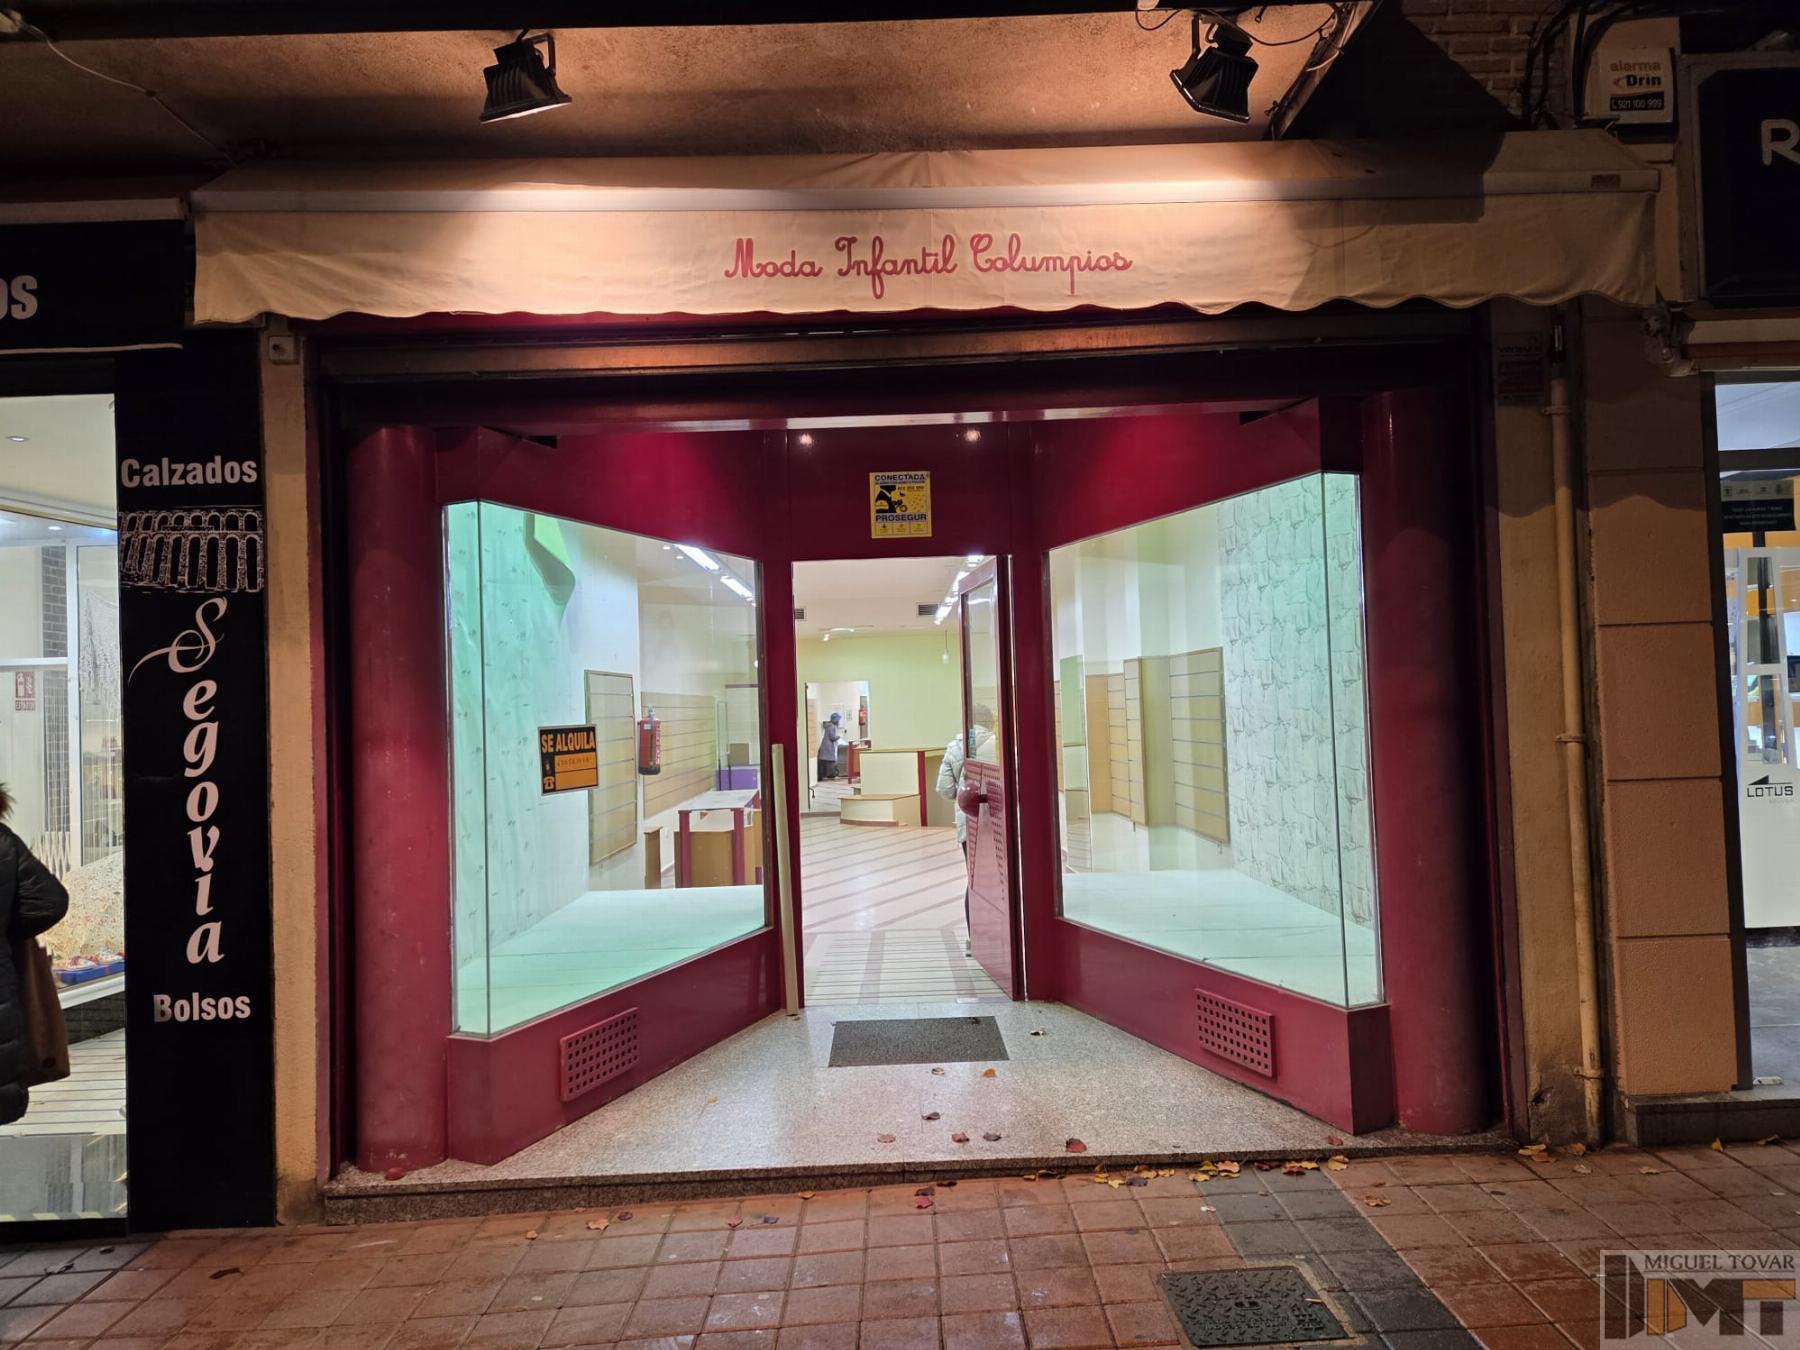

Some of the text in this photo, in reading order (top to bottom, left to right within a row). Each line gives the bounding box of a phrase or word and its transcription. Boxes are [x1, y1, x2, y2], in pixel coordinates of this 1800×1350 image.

[1610, 60, 1661, 71] alarma
[1626, 74, 1661, 86] Drin
[724, 232, 1133, 300] Moda Infantil Columpios
[121, 455, 258, 488] Calzados
[876, 513, 927, 522] PROSEGUR
[541, 731, 595, 754] SE ALQUILA
[1747, 786, 1793, 798] LOTUS
[153, 992, 252, 1023] Bolsos
